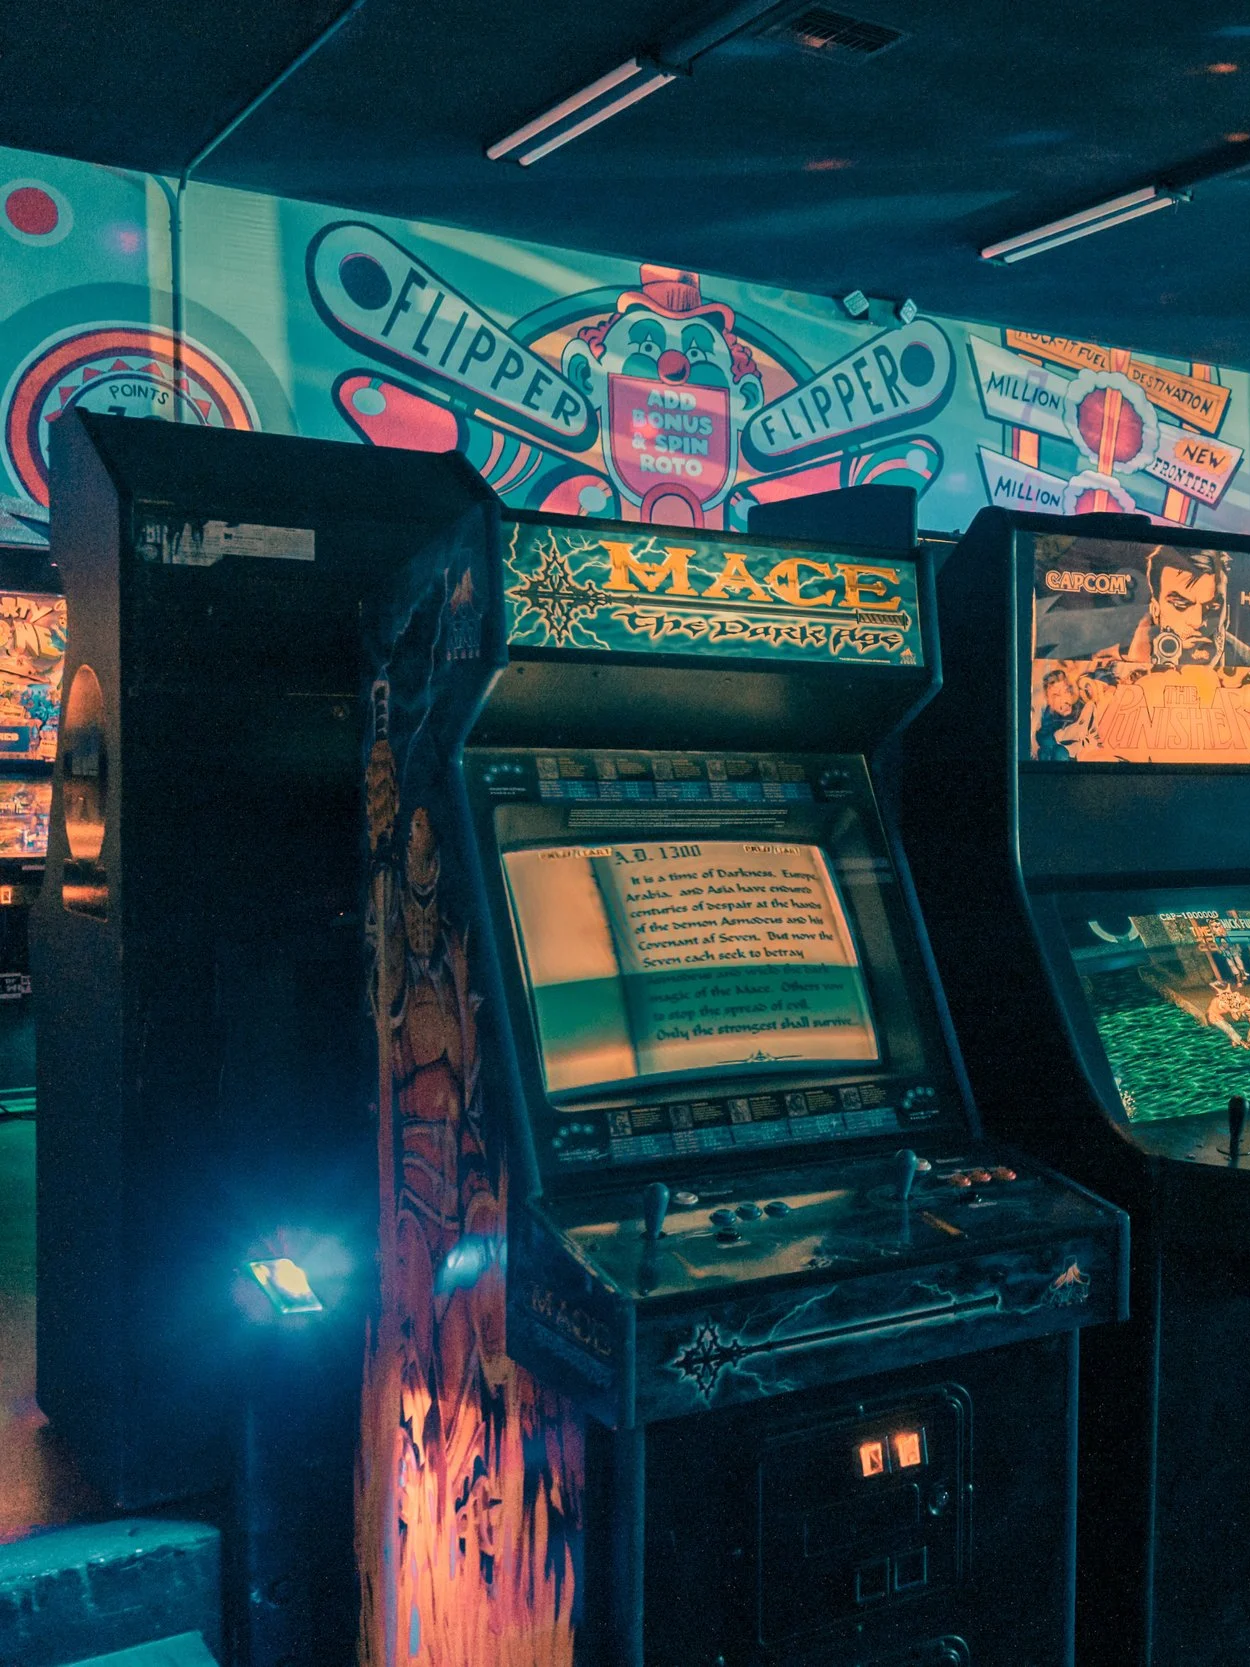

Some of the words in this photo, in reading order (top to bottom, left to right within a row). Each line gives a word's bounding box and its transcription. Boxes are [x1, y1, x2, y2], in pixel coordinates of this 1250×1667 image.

[377, 268, 582, 436] FLIPPER
[1078, 347, 1106, 368] FUEL
[109, 384, 169, 405] POINTS
[648, 389, 697, 410] ADD
[761, 344, 910, 446] FLIPPER
[986, 371, 1061, 411] MILLION
[1133, 370, 1214, 416] DESTINATION
[632, 408, 713, 435] BONUS
[632, 431, 647, 449] &
[654, 434, 709, 455] SPIN
[640, 454, 703, 476] ROTO
[1182, 445, 1226, 469] NEW
[1152, 457, 1218, 500] FRONTIER
[994, 475, 1061, 507] MILLION
[600, 541, 902, 612] MACE
[1046, 570, 1131, 595] CAPCOM
[1163, 685, 1201, 708] THE
[615, 848, 654, 866] A.D.
[661, 844, 702, 859] 1300
[644, 875, 654, 884] is
[669, 871, 698, 881] time
[702, 868, 714, 879] of
[680, 887, 704, 898] and
[707, 884, 735, 895] Asia
[737, 883, 766, 894] have
[769, 884, 813, 895] endured
[630, 904, 688, 919] centuries
[692, 901, 704, 912] of
[706, 899, 752, 914] despair
[756, 899, 768, 909] at
[771, 898, 789, 909] the
[791, 898, 822, 910] hands
[635, 923, 646, 934] of
[649, 921, 669, 932] the
[672, 918, 718, 931] demon
[721, 915, 783, 927] Asmodeus
[786, 914, 808, 925] and
[808, 914, 824, 926] his
[638, 936, 699, 951] Covenant
[719, 932, 761, 945] Seven.
[767, 931, 788, 942] But
[791, 931, 816, 942] now
[819, 930, 834, 942] the
[643, 955, 681, 968] Seven
[684, 948, 715, 963] each
[718, 948, 746, 961] seek
[749, 947, 761, 959] to
[764, 947, 804, 962] betray
[710, 984, 731, 997] the
[699, 1004, 721, 1018] the
[725, 1001, 768, 1018] spread
[771, 999, 783, 1012] of
[656, 1026, 690, 1041] Only
[692, 1023, 714, 1037] the
[717, 1017, 778, 1035] strongest
[781, 1016, 810, 1030] shall
